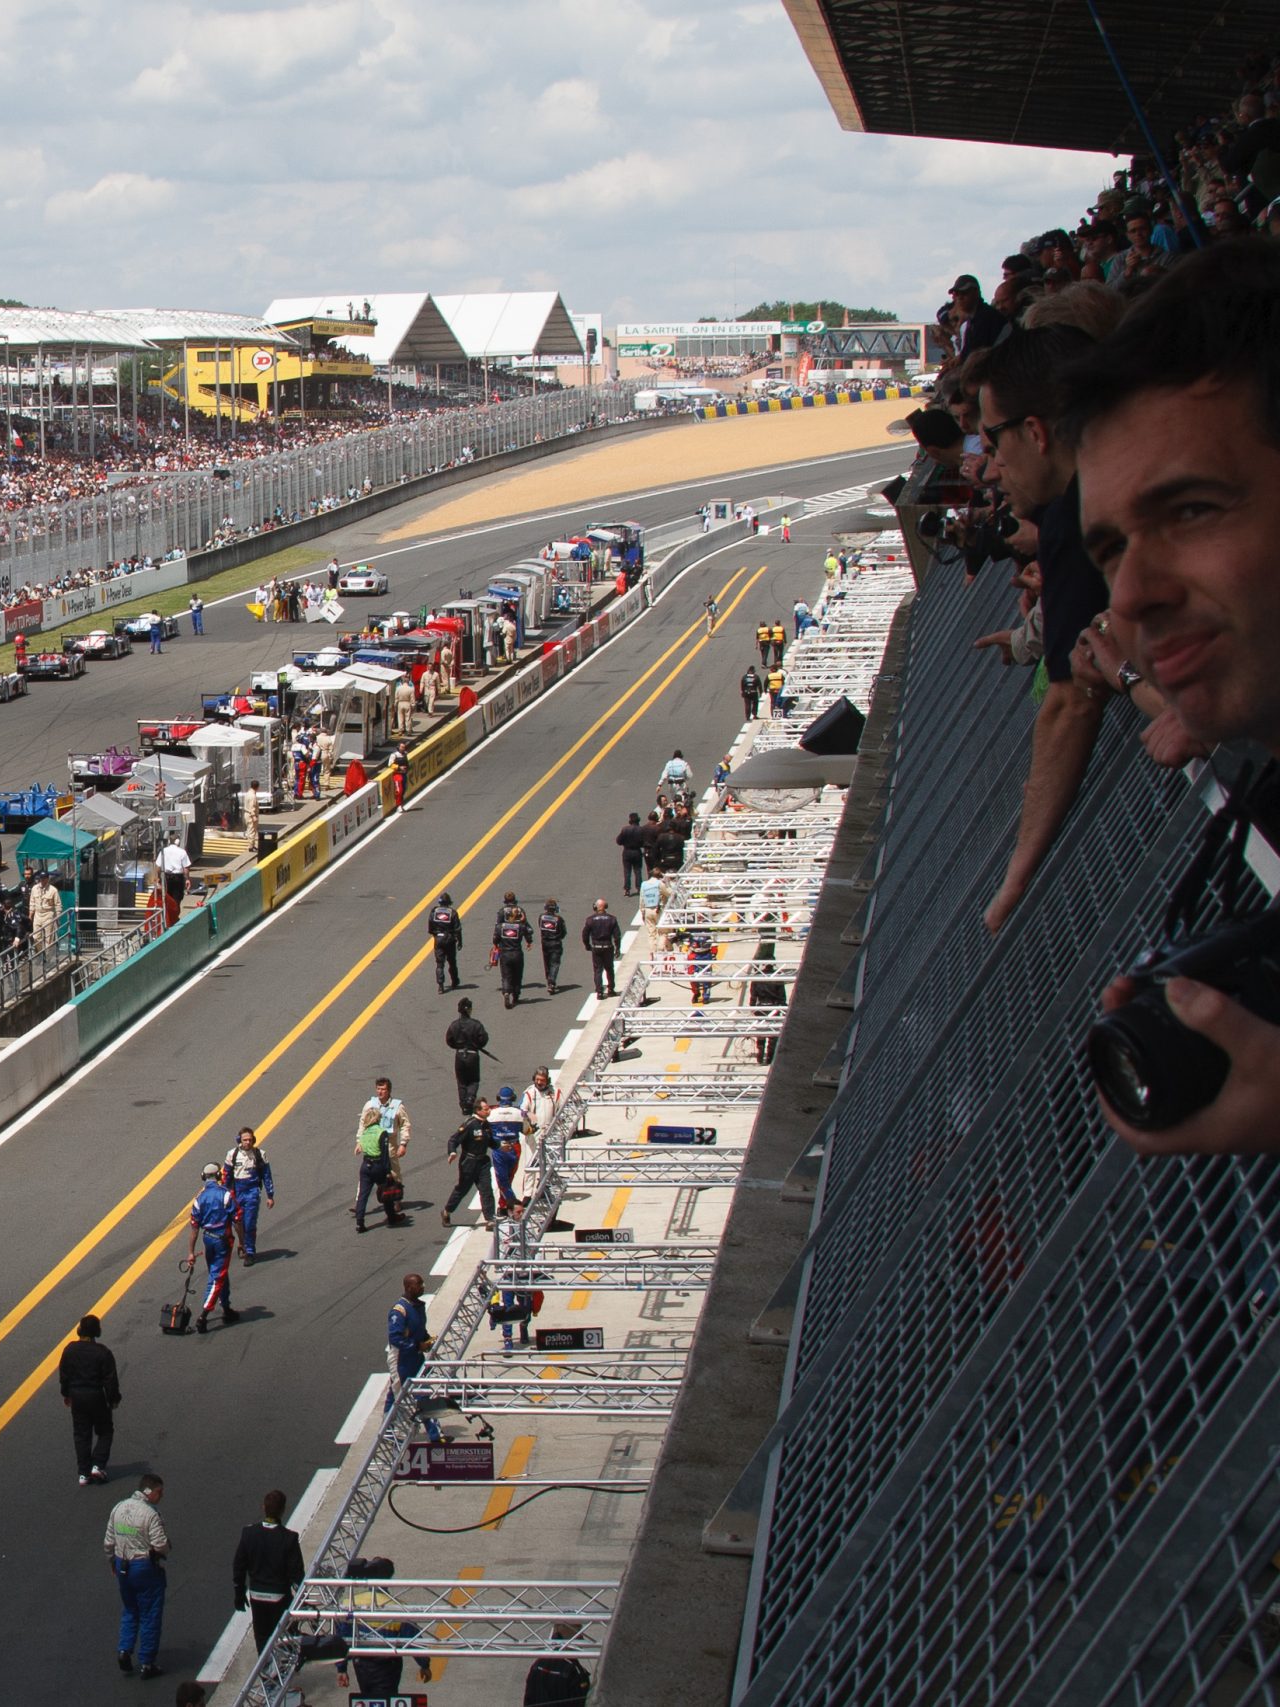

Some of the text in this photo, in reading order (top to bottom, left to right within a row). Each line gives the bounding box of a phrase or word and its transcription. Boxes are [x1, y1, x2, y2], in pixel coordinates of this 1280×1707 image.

[625, 326, 639, 334] LA
[712, 325, 726, 333] EN
[729, 325, 746, 333] EST
[620, 349, 649, 357] Sarthe
[694, 1127, 717, 1145] 32
[614, 1231, 630, 1243] 20
[545, 1331, 601, 1346] psilon 21
